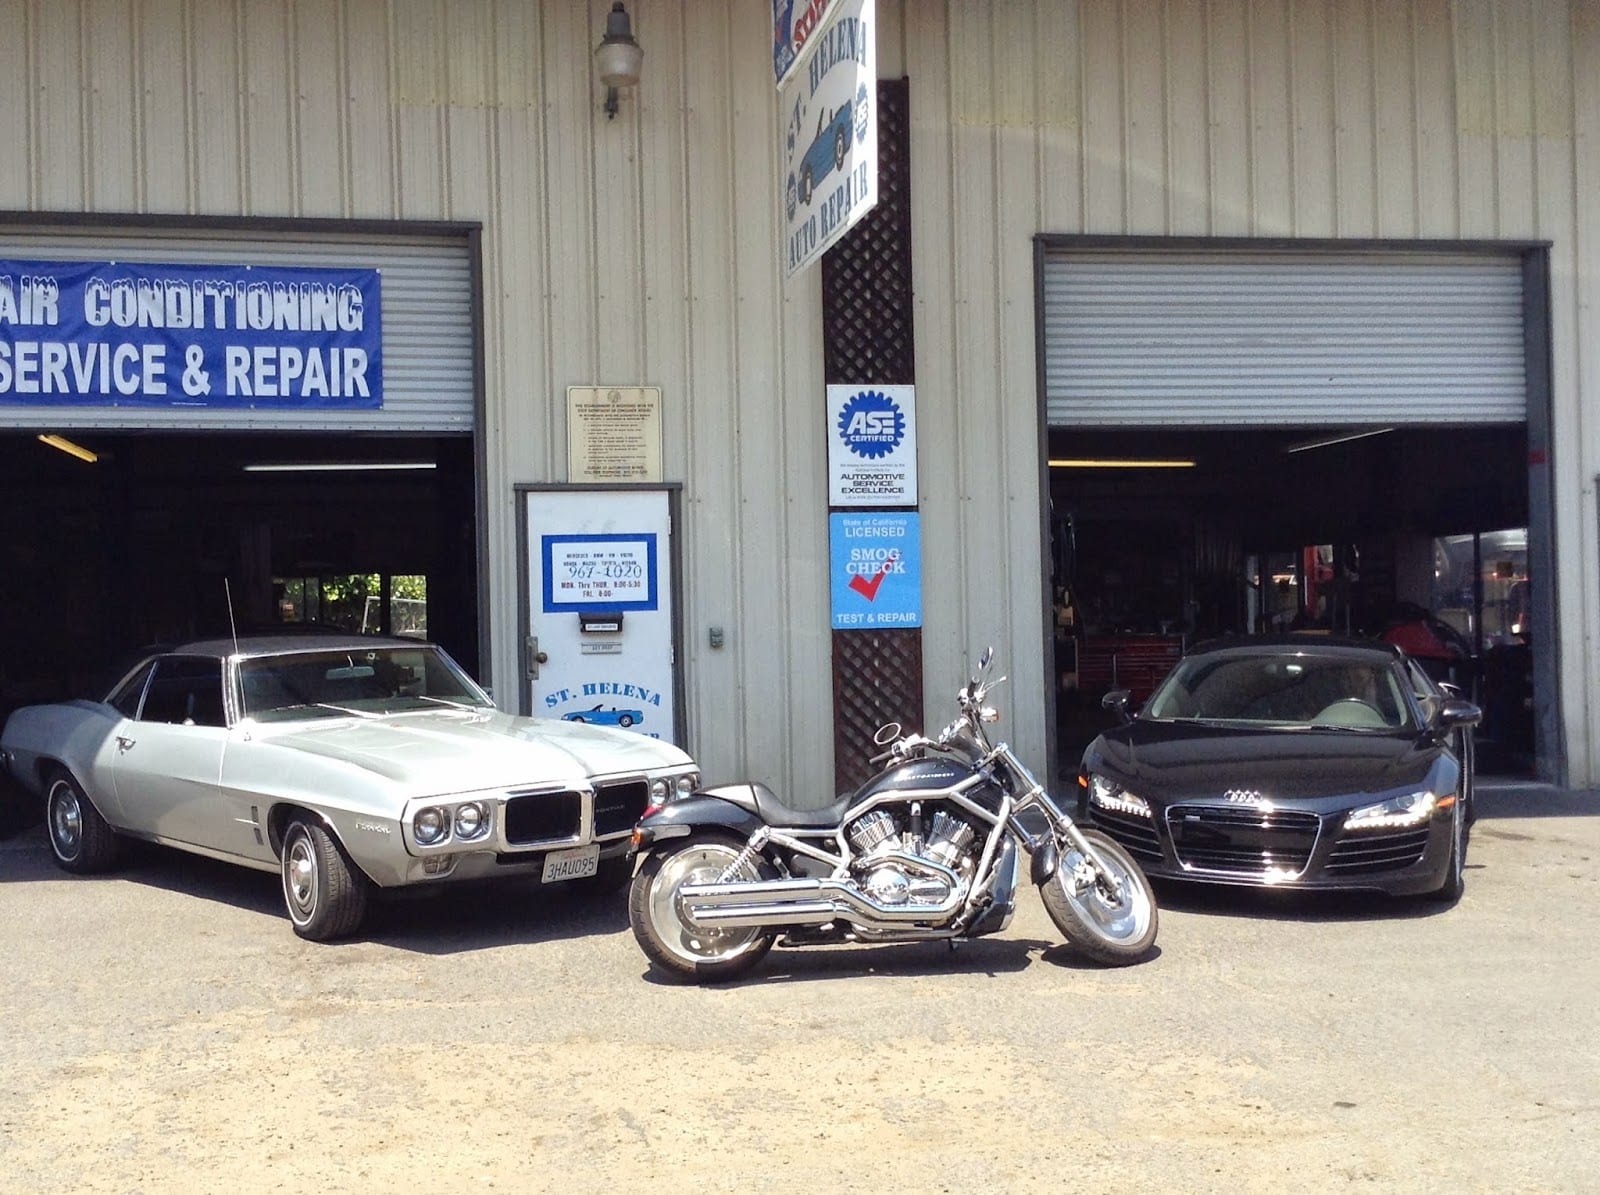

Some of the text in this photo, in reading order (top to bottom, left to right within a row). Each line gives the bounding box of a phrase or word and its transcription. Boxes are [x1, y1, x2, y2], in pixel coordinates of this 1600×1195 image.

[810, 17, 867, 100] HELENA
[789, 216, 816, 270] AUTO
[821, 160, 868, 242] REPAIR
[0, 275, 364, 332] AIR CONDITIONING
[0, 341, 371, 398] SERVICE & REPAIR
[846, 411, 896, 435] ASE
[843, 518, 908, 526] State of California
[845, 527, 905, 537] LICENSED
[850, 548, 901, 561] SMOG
[845, 561, 905, 574] CHECK
[837, 612, 917, 624] TEST & REPAIR
[545, 682, 662, 708] ST. HELENA
[547, 856, 595, 879] 3HAU095
